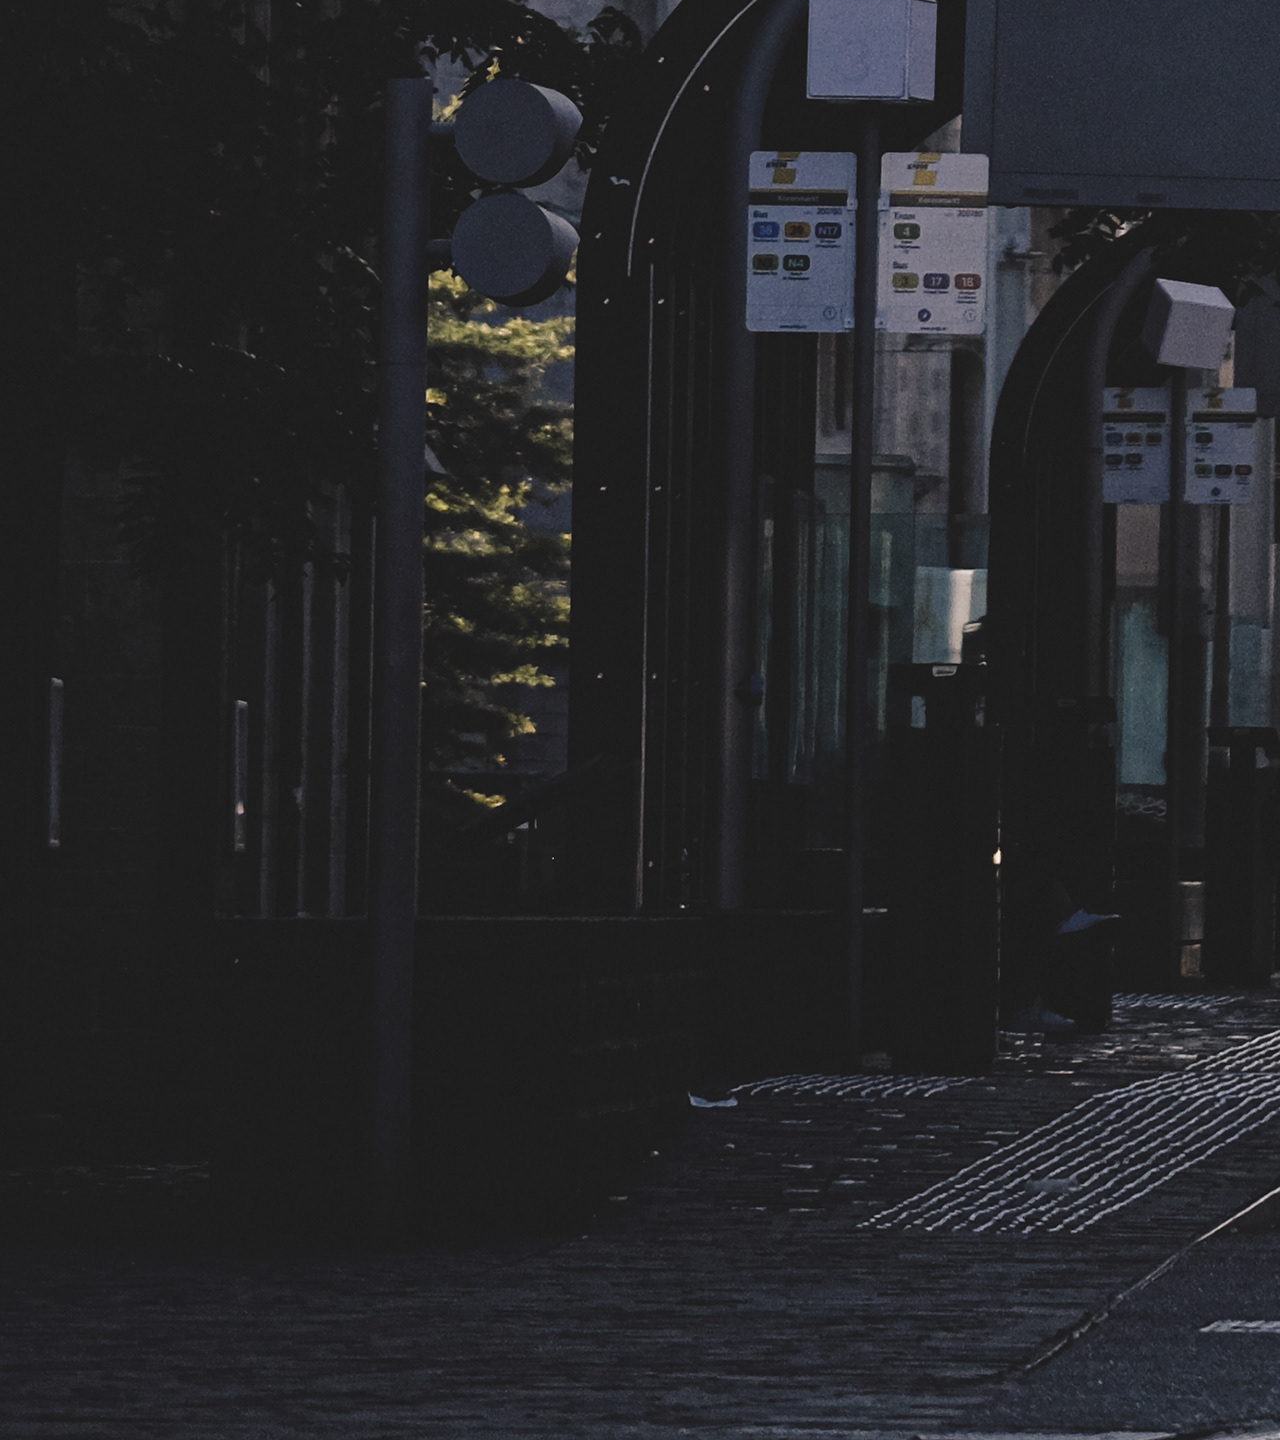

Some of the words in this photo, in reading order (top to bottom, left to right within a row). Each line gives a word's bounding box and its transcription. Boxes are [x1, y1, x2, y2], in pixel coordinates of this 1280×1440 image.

[760, 225, 773, 234] 38
[818, 226, 838, 235] NT7
[902, 227, 910, 237] 4
[788, 258, 804, 268] N4
[931, 276, 943, 286] 17
[961, 276, 974, 287] 18
